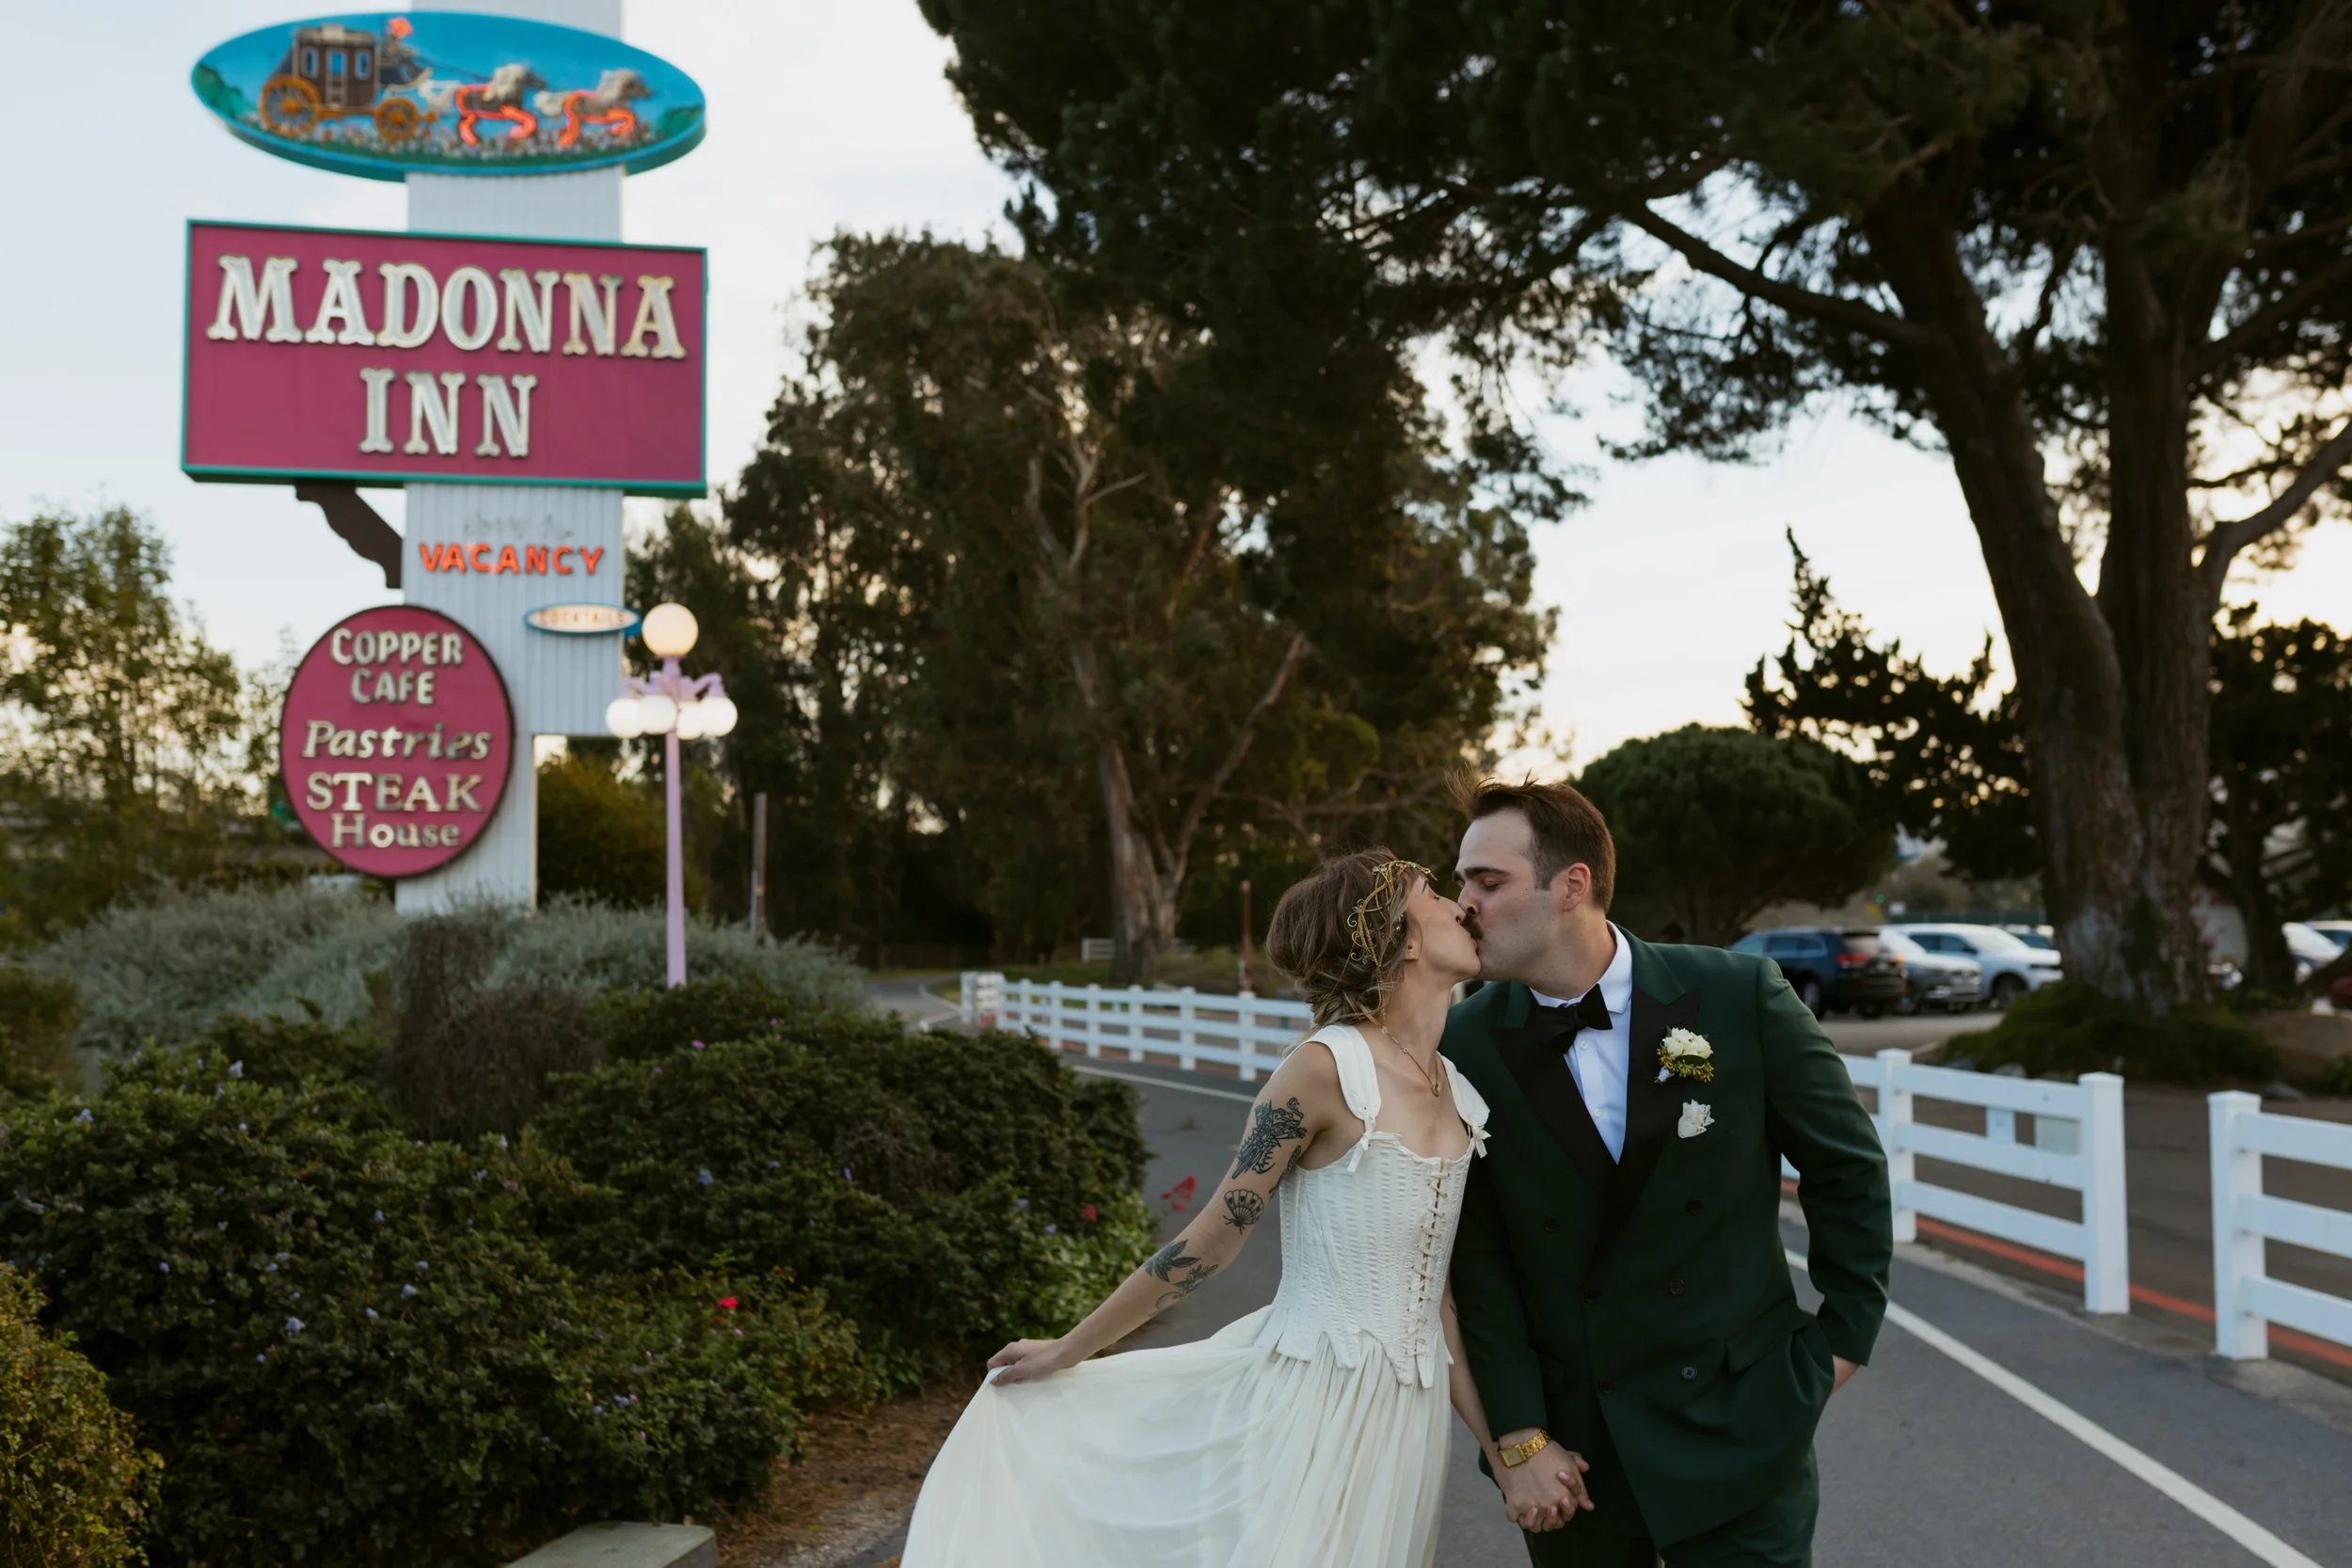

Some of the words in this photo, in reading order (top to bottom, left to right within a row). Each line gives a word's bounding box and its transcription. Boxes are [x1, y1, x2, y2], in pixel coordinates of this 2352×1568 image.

[206, 254, 688, 360] MADONNA
[358, 367, 538, 458] INN
[419, 541, 604, 577] VACANCY
[331, 627, 463, 666] COPPER
[350, 667, 435, 705] CAFE
[301, 720, 493, 760] Pastries
[306, 771, 484, 813] STEAK
[330, 812, 461, 848] House
